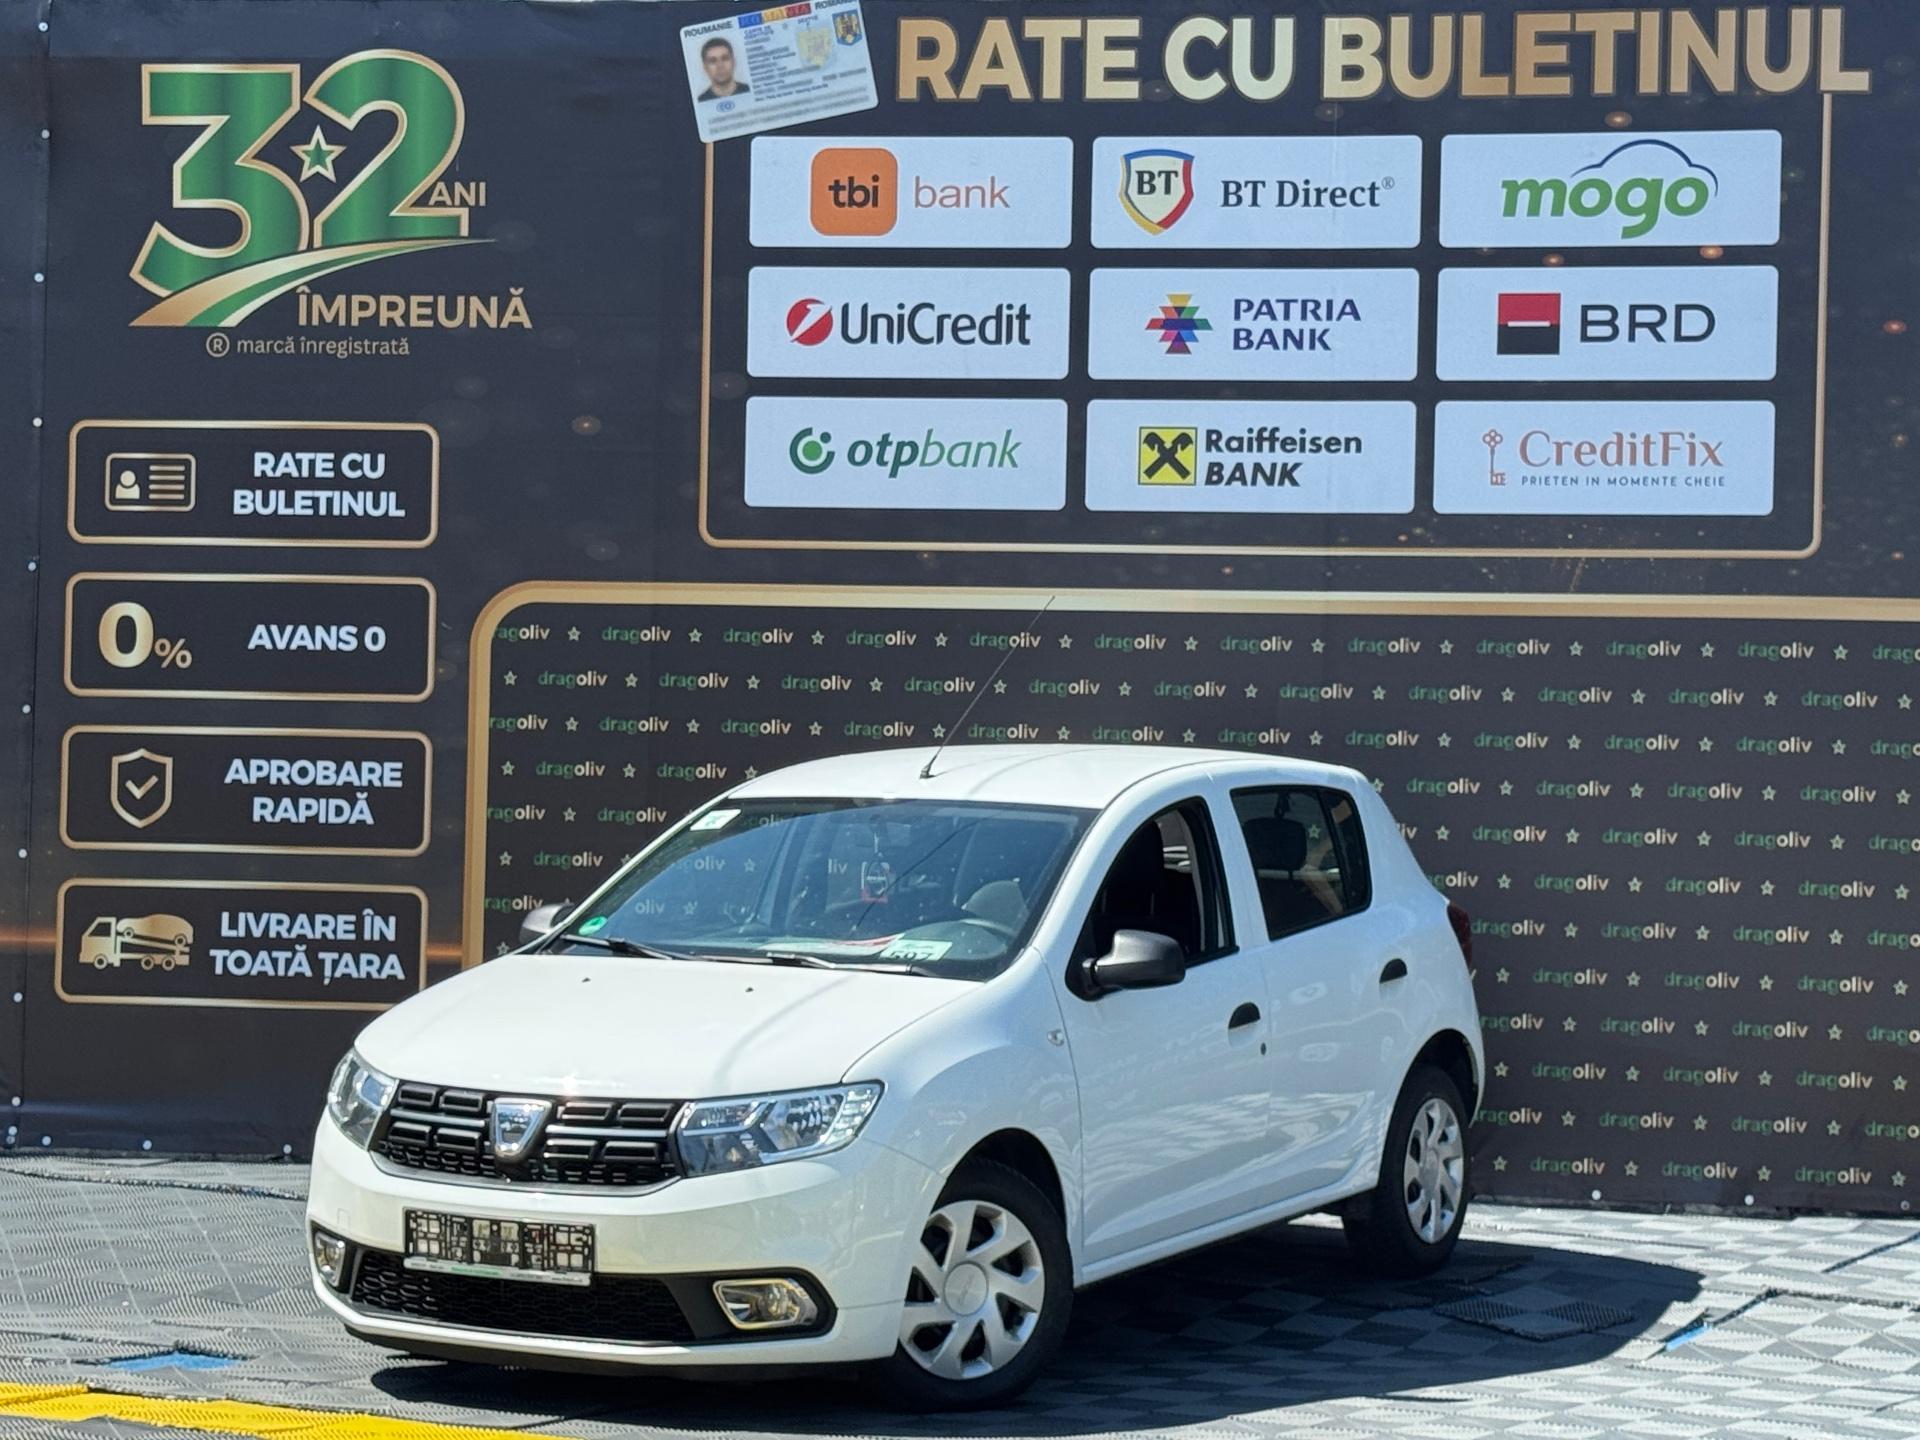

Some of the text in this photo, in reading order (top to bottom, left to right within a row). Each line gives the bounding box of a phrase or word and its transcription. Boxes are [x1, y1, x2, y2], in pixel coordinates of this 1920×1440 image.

[898, 17, 1141, 101] RATE
[1163, 16, 1295, 101] CU
[1320, 7, 1871, 100] BULETINUL
[428, 182, 487, 207] ANI
[828, 180, 880, 210] tbi
[914, 177, 1011, 210] bank
[1134, 169, 1179, 196] BT
[1220, 179, 1267, 208] BT
[1501, 176, 1709, 240] mogo
[295, 285, 533, 329] ÎMPREUNĂ
[1232, 297, 1362, 323] PATRIA
[840, 300, 1031, 347] UniCredit
[1580, 304, 1716, 344] BRD
[237, 336, 295, 355] marcă
[300, 336, 410, 359] înregistrată
[1232, 329, 1332, 352] BANK
[846, 429, 1022, 479] otpbank
[1205, 428, 1363, 457] Raiffeisen
[1519, 430, 1724, 468] CreditFix
[252, 451, 386, 480] RATE CU
[1204, 461, 1303, 488] BANK
[1521, 476, 1726, 487] PRIETEN IN MOMENTE CHEIE
[231, 489, 406, 518] BULETINUL
[247, 624, 358, 651] AVANS
[494, 625, 550, 642] agoliv
[602, 626, 671, 644] dragoliv
[724, 628, 793, 646] dragoliv
[847, 630, 916, 648] dragoliv
[969, 632, 1041, 651] dragoliv
[1095, 634, 1166, 652] dragoliv
[1221, 636, 1292, 654] dragoliv
[1348, 637, 1421, 656] dragoliv
[1477, 639, 1550, 657] dragoliv
[1607, 640, 1681, 659] dragoliv
[1738, 642, 1814, 661] dragoliv
[538, 670, 1878, 710] dragoliv dragoliv dragoliv dragoliv dragoliv dragoliv dragoliv dragoliv dragoliv dragoliv dragoliv
[489, 714, 1920, 759] ragoliv dragoliv dragoliv dragoliv dragoliv dragoliv dragoliv dragoliv dragoliv dragoliv dragoliv drago
[223, 758, 404, 789] APROBARE
[536, 761, 1876, 804] dragoliv dragoliv dragoliv dragoliv dragoliv dragoliv
[252, 792, 374, 826] RAPIDĂ
[487, 804, 1920, 854] ragoliv dragoliv dragoliv dragoliv dragoliv drago
[534, 851, 603, 870] dragoliv
[1535, 874, 1609, 893] dragoliv
[1666, 877, 1741, 896] dragoliv
[1799, 880, 1875, 899] dragoliv
[485, 894, 543, 913] ragoliv
[219, 908, 397, 941] LIVRARE ÎN
[1471, 919, 1920, 950] dragoliv dragoliv dragoliv drago
[208, 944, 406, 987] TOATĂ ȚARA
[1533, 968, 1874, 995] dragoliv dragoliv dragoliv
[1479, 1013, 1920, 1046] ragoliv dragoliv dragoliv drago
[1533, 1063, 1873, 1090] dragoliv dragoliv dragoliv
[1600, 1111, 1674, 1130] dragoliv
[1732, 1116, 1807, 1135] dragoliv
[1865, 1121, 1920, 1140] drago
[1531, 1157, 1872, 1185] dragoliv dragoliv dragoliv
